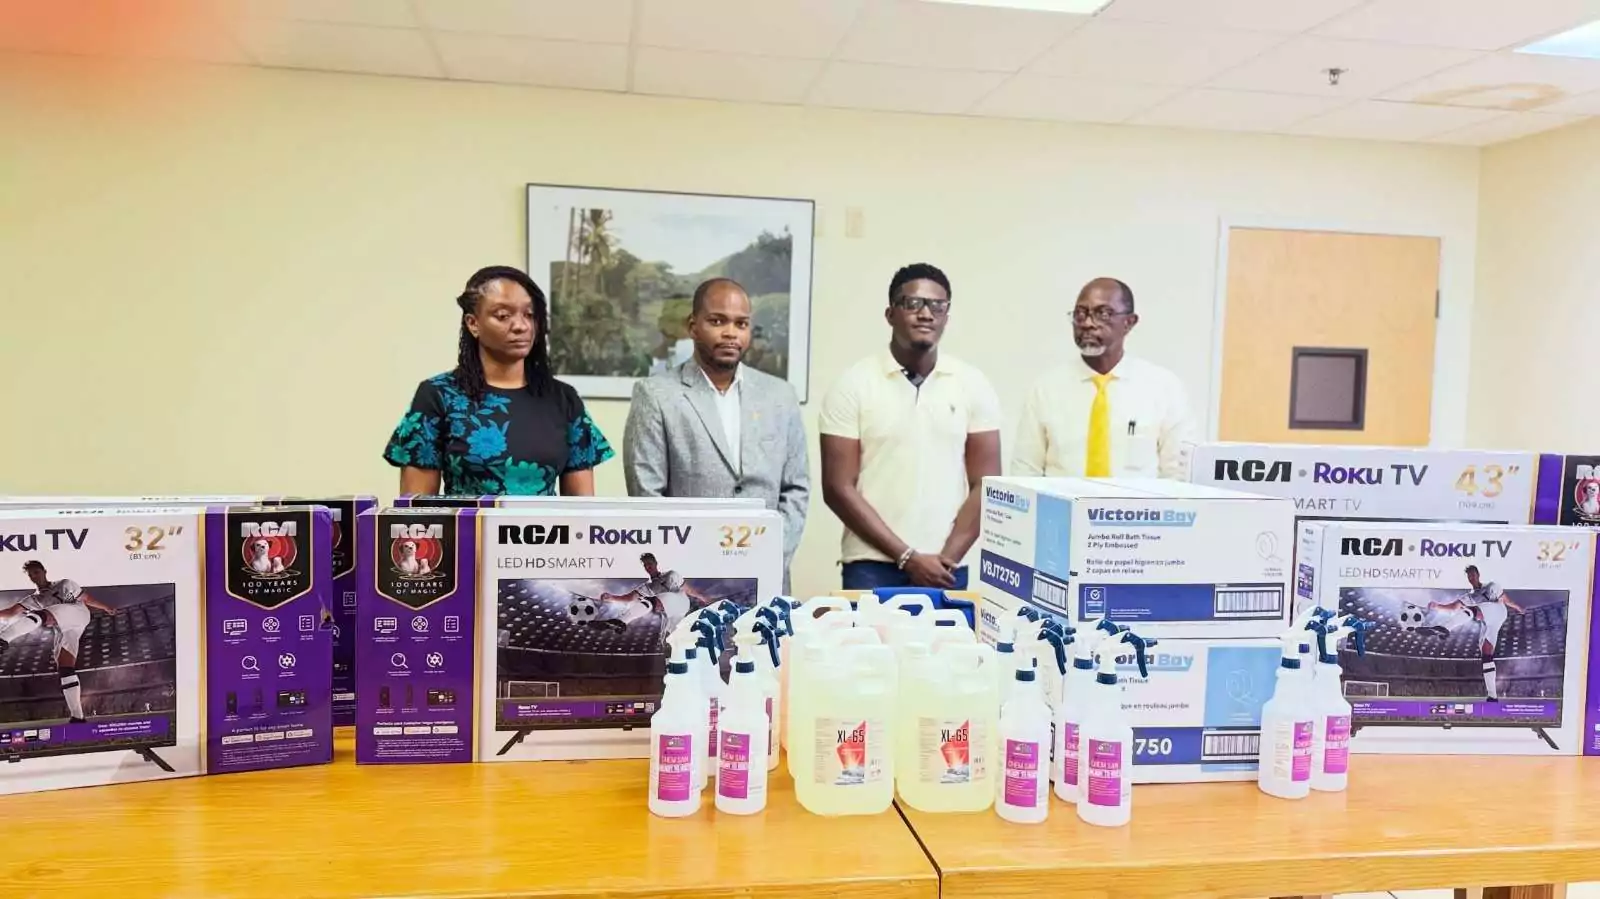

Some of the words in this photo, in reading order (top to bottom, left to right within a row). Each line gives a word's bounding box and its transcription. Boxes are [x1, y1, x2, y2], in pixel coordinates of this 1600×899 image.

[1214, 459, 1292, 482] RCA
[1313, 462, 1383, 485] Roku
[1391, 464, 1429, 486] TV
[986, 486, 1015, 504] Victoria
[1293, 497, 1336, 511] MART
[1342, 498, 1362, 511] TV
[1087, 508, 1160, 521] Victoria
[1163, 509, 1196, 523] Bay
[241, 520, 297, 537] RCA
[390, 523, 443, 539] RCA
[498, 524, 570, 545] RCA
[589, 524, 652, 545] Roku
[658, 525, 692, 545] TV
[0, 533, 37, 551] ku
[45, 528, 89, 550] TV
[1340, 537, 1403, 556] RCA
[1420, 538, 1476, 557] Roku
[1482, 540, 1512, 558] TV
[497, 557, 522, 569] LED
[525, 557, 546, 569] HD
[547, 557, 595, 569] SMART
[598, 557, 615, 569] TV
[982, 558, 1021, 588] VBJT2750
[1339, 567, 1361, 578] LED
[1363, 567, 1381, 578] HD
[1382, 568, 1424, 579] SMART
[1427, 568, 1442, 579] TV
[243, 580, 262, 588] 100
[268, 579, 298, 587] YEARS
[1158, 653, 1194, 666] Bay
[1135, 738, 1173, 756] 750
